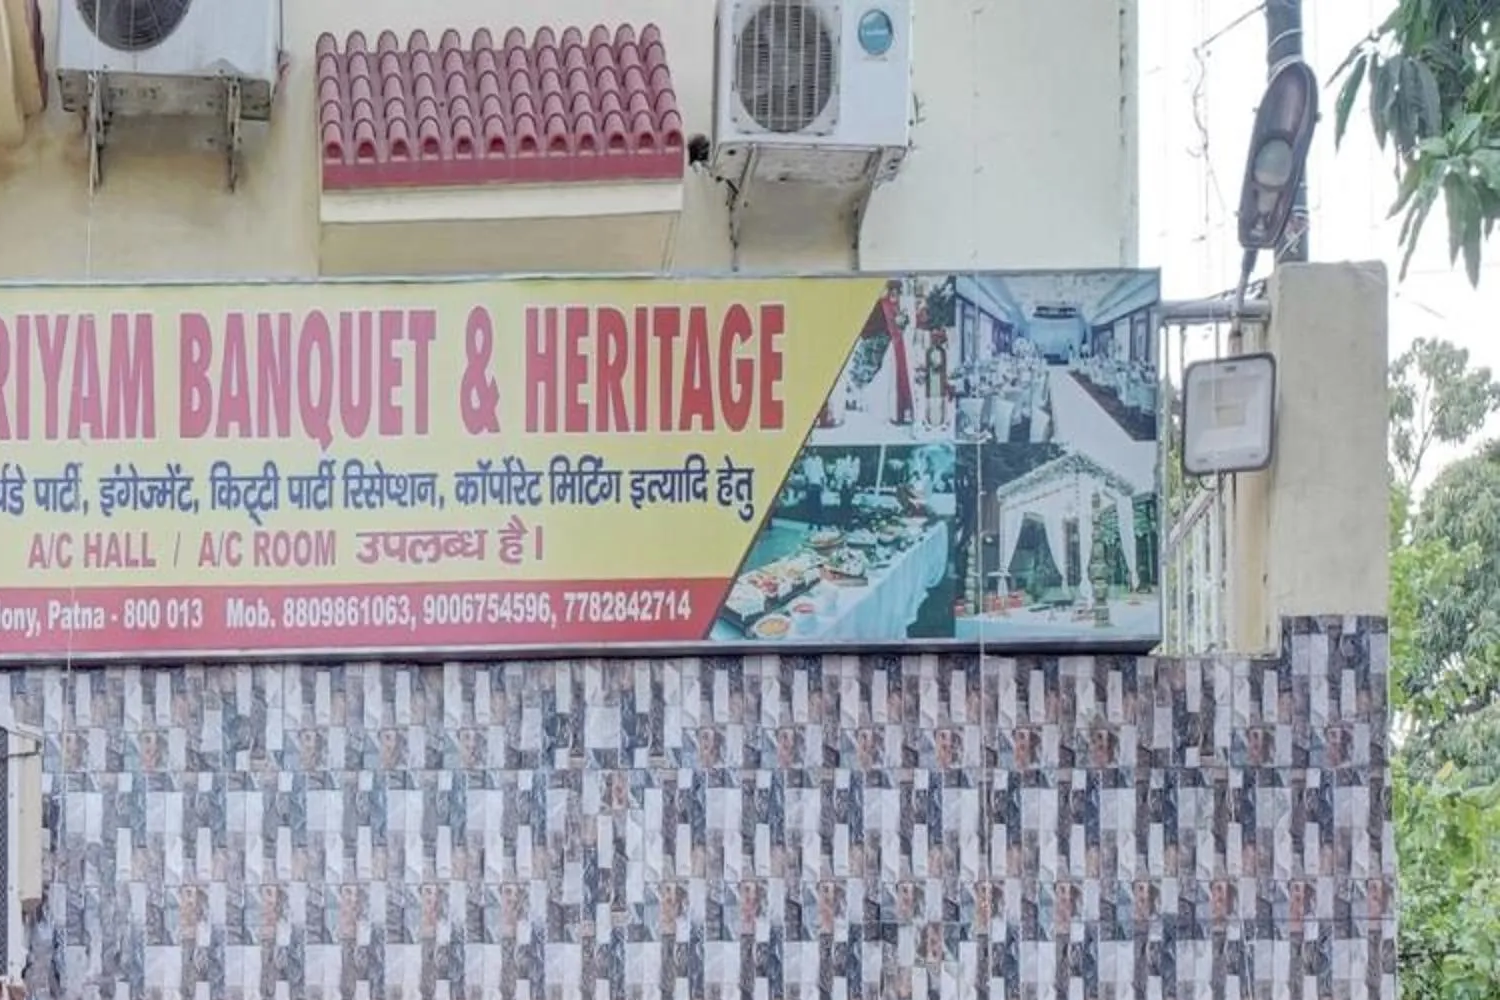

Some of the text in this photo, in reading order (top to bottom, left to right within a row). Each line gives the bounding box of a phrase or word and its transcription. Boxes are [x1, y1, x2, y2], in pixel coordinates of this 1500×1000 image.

[179, 309, 436, 452] BANQUET
[460, 305, 500, 436] &
[525, 303, 786, 433] HERITAGE
[32, 461, 89, 516] पार्टी,
[288, 459, 336, 510] पार्टी
[342, 459, 445, 509] रिसेप्शन,
[630, 453, 709, 509] इत्यादि
[716, 455, 755, 521] हेतु
[28, 532, 74, 569] A/C
[83, 531, 157, 569] HALL
[198, 531, 243, 568] A/C
[254, 530, 336, 567] ROOM
[355, 529, 488, 565] उपलब्ध
[48, 599, 105, 631] Patna
[124, 599, 160, 629] 800
[167, 598, 203, 628] 013
[227, 597, 276, 628] Mob.
[283, 594, 417, 631] 8809861063,
[423, 592, 557, 628] 9006754596,
[564, 589, 692, 623] 7782842714
